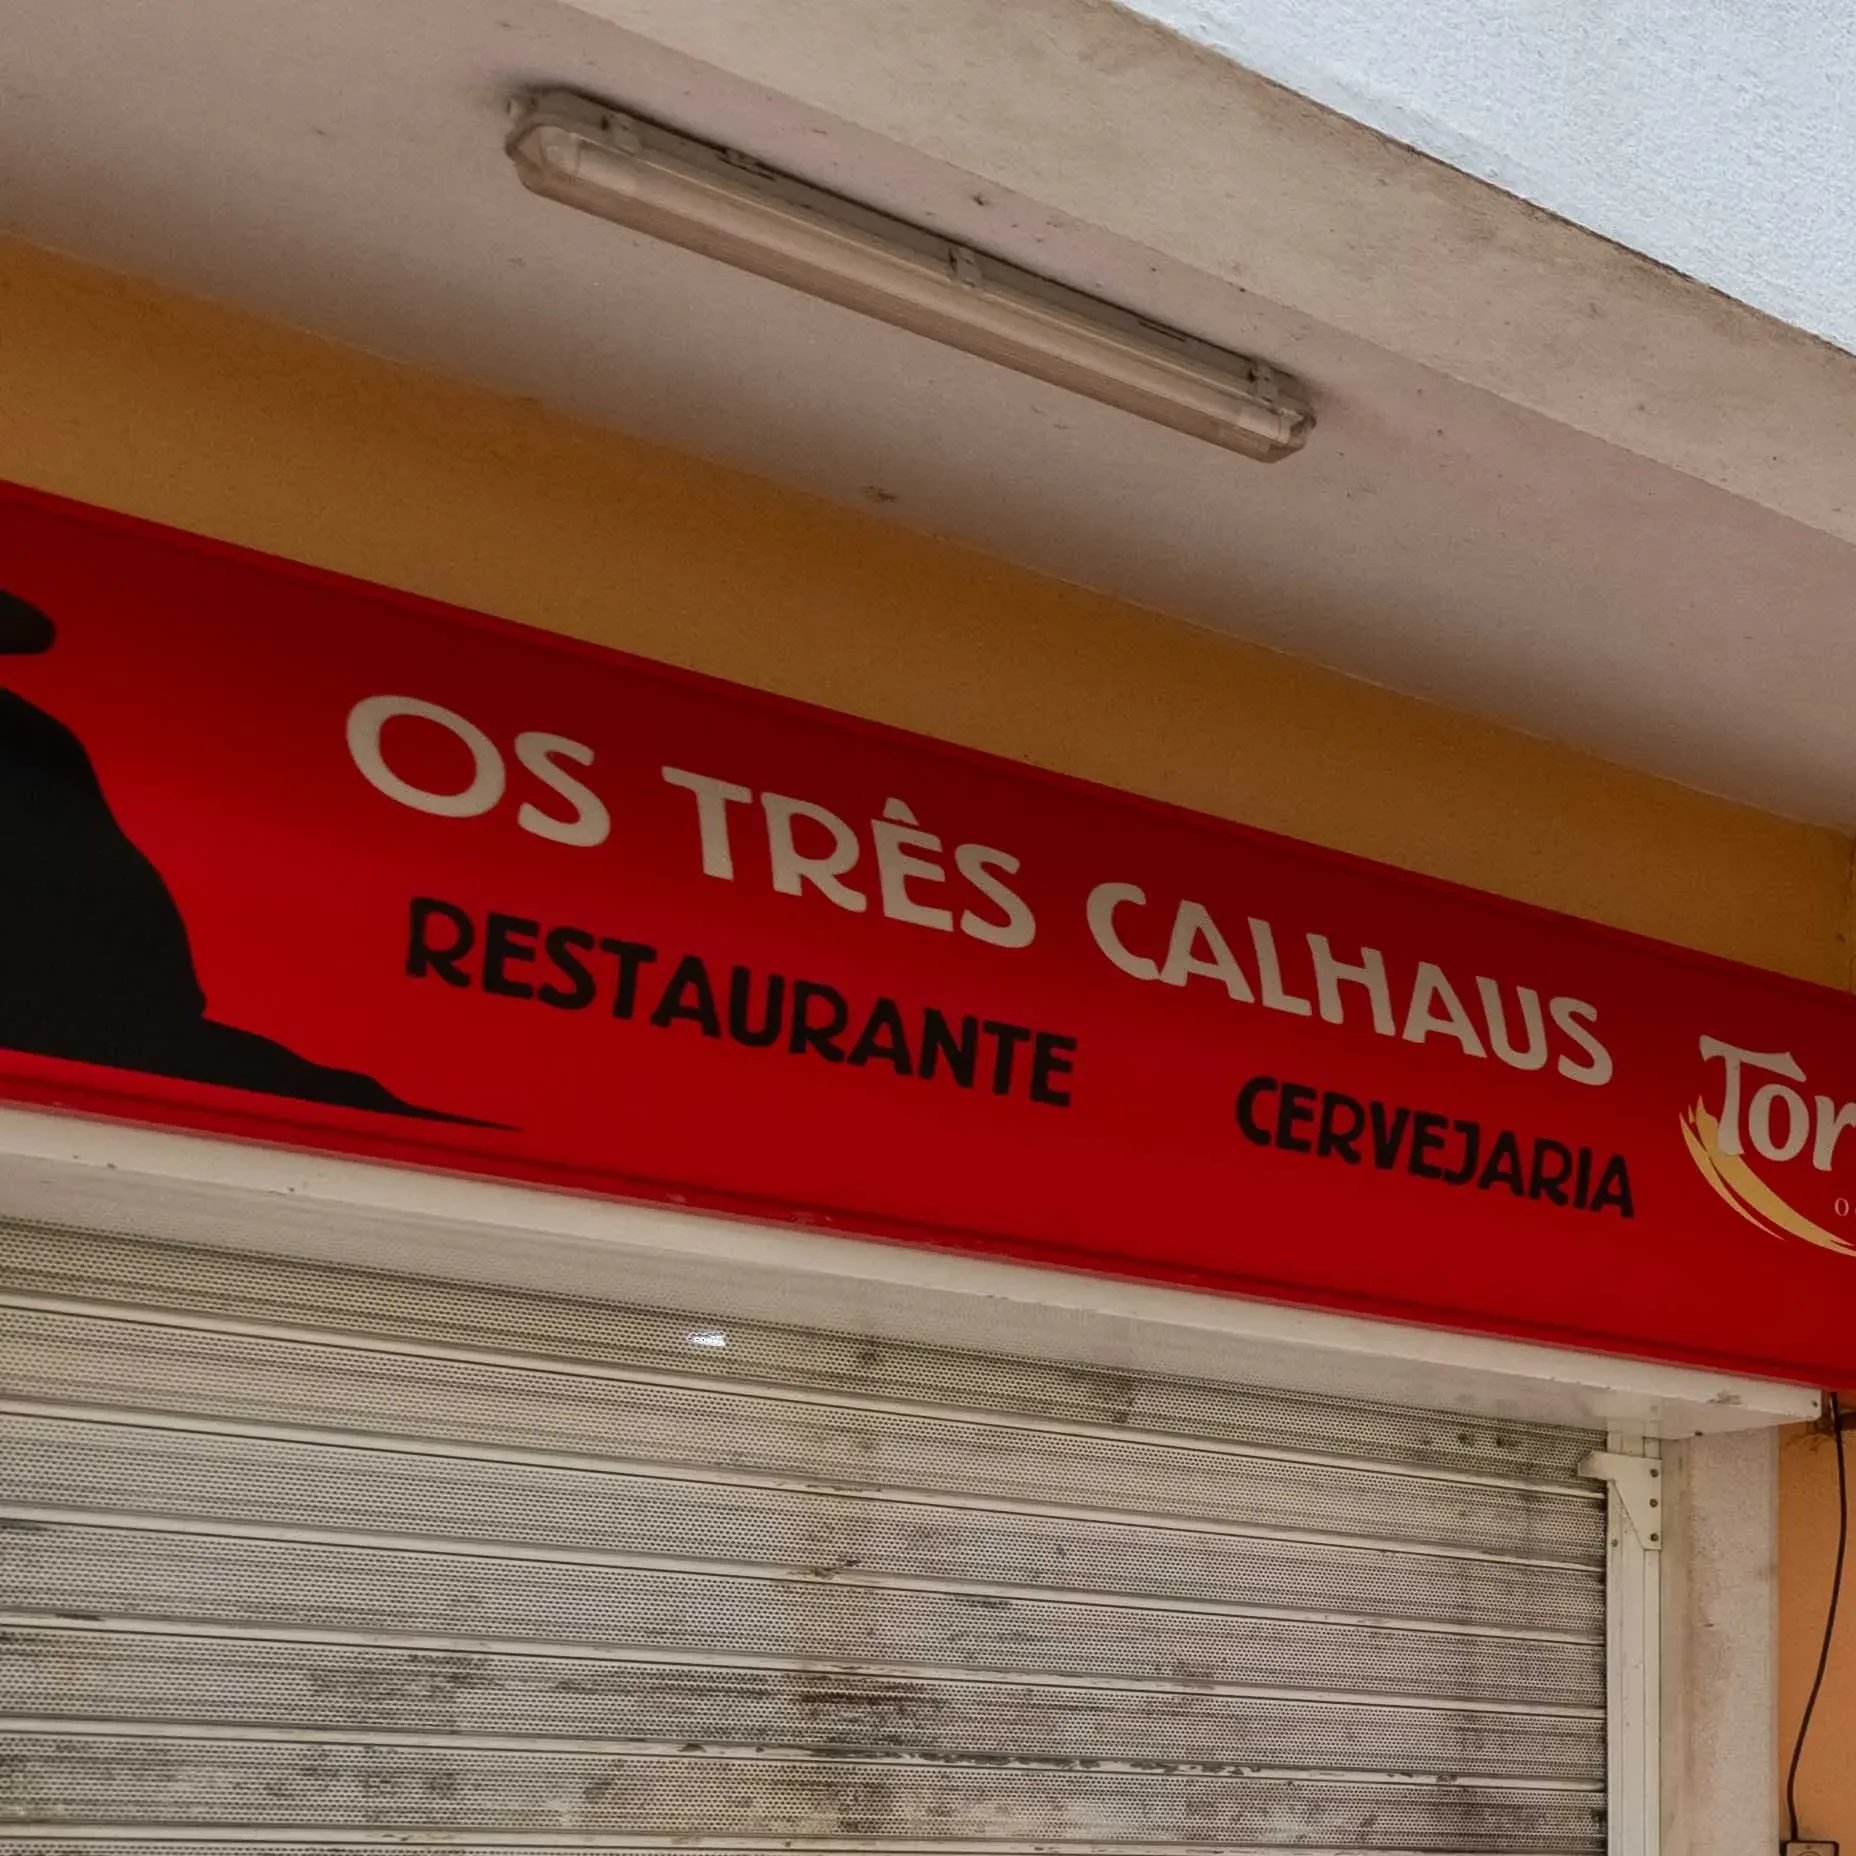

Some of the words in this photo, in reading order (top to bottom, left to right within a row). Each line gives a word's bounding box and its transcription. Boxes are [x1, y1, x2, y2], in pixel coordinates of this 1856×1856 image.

[345, 694, 611, 848] OS
[661, 765, 1037, 950] TRÊS
[1086, 881, 1614, 1086] CALHAUS
[405, 896, 1078, 1108] RESTAURANTE
[1235, 1075, 1635, 1218] CERVEJARIA
